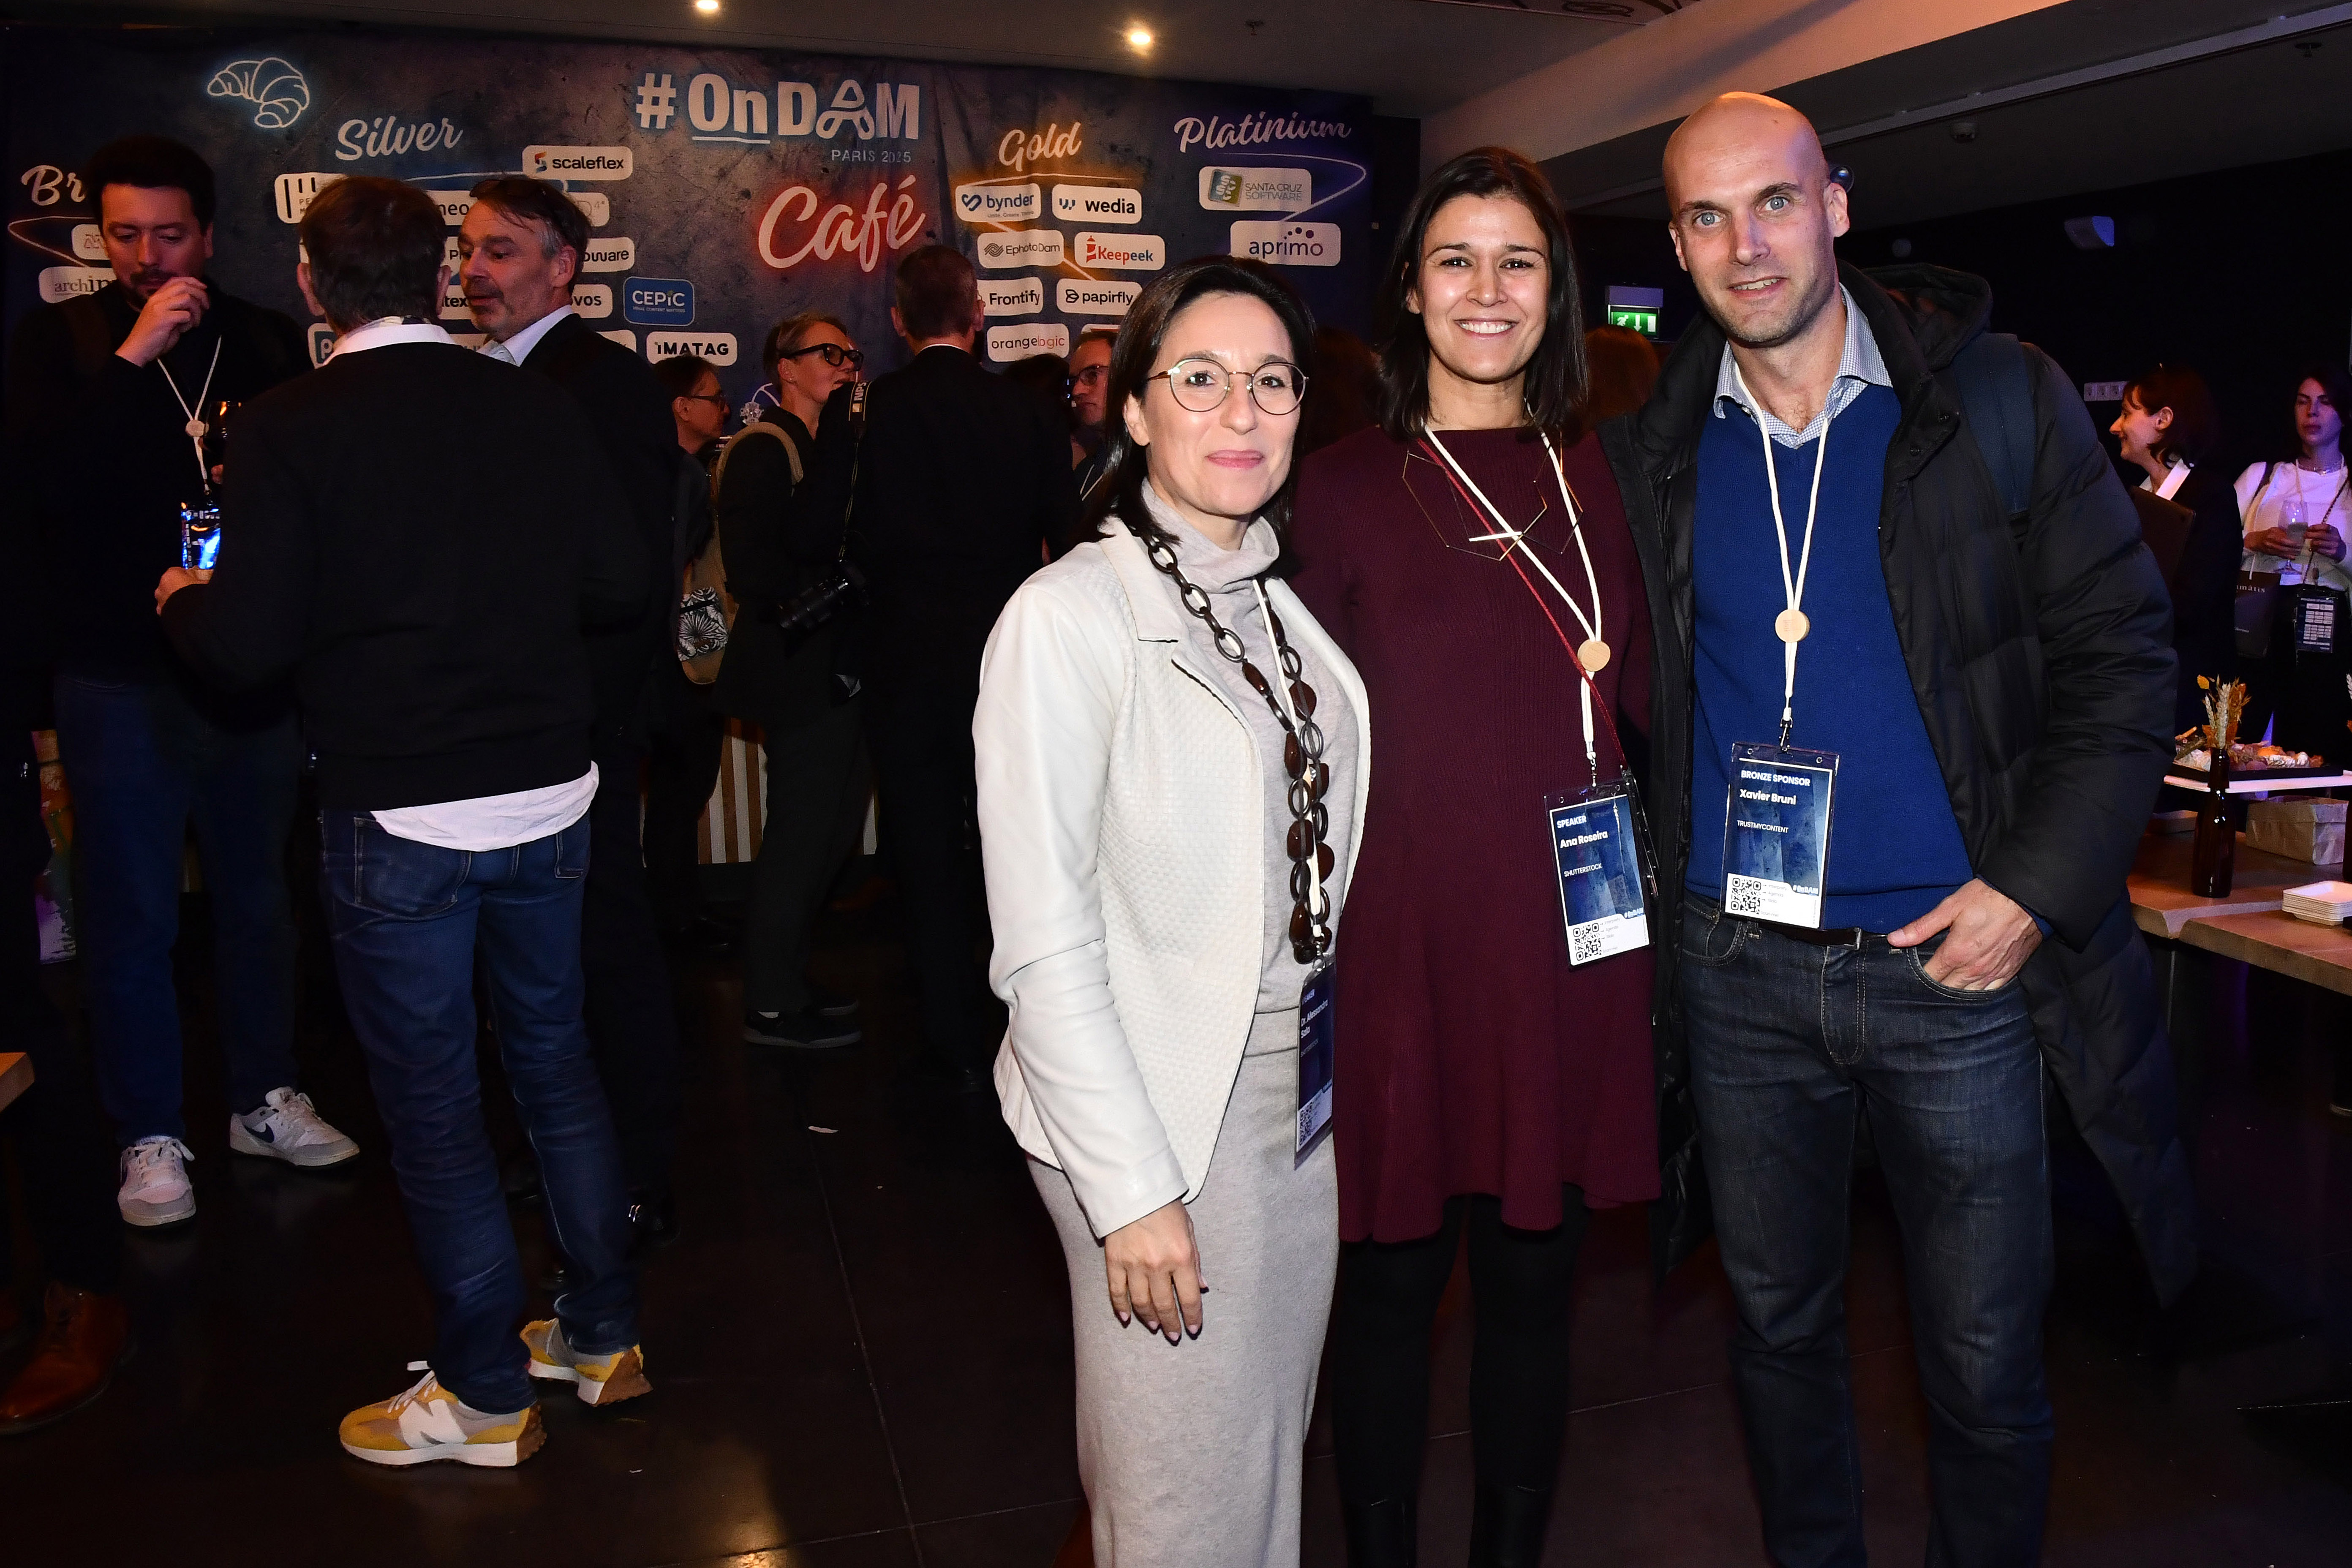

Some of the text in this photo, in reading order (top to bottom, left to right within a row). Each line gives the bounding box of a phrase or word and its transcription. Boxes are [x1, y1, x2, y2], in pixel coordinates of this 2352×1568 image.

[335, 116, 463, 161] Silver
[1174, 111, 1351, 152] Platinium
[999, 122, 1082, 172] Gold
[553, 156, 624, 169] scaleflex
[832, 150, 911, 163] PARIS 2025
[21, 165, 86, 206] Br
[1246, 183, 1302, 192] SANTA CRUZ
[987, 193, 1034, 211] bynder
[1246, 192, 1302, 201] SOFTWARE
[438, 204, 469, 215] neo
[1085, 198, 1135, 214] wedia
[758, 175, 926, 272] Café
[1098, 246, 1153, 265] Keepeek
[1249, 237, 1323, 259] aprimo
[443, 297, 468, 308] tex
[572, 296, 602, 306] vos
[989, 290, 1040, 305] Frontify
[1082, 291, 1133, 306] papirfly
[853, 382, 867, 401] NPS
[1741, 770, 1811, 787] BRONZE SPONSOR
[1740, 789, 1797, 805] Xavier Bruni
[1557, 815, 1587, 829] SPEAKER
[1737, 819, 1789, 833] TRUSTMYCONTENT
[1560, 830, 1608, 849] Ana Roseira
[1564, 863, 1603, 877] SHUTTERSTOCK
